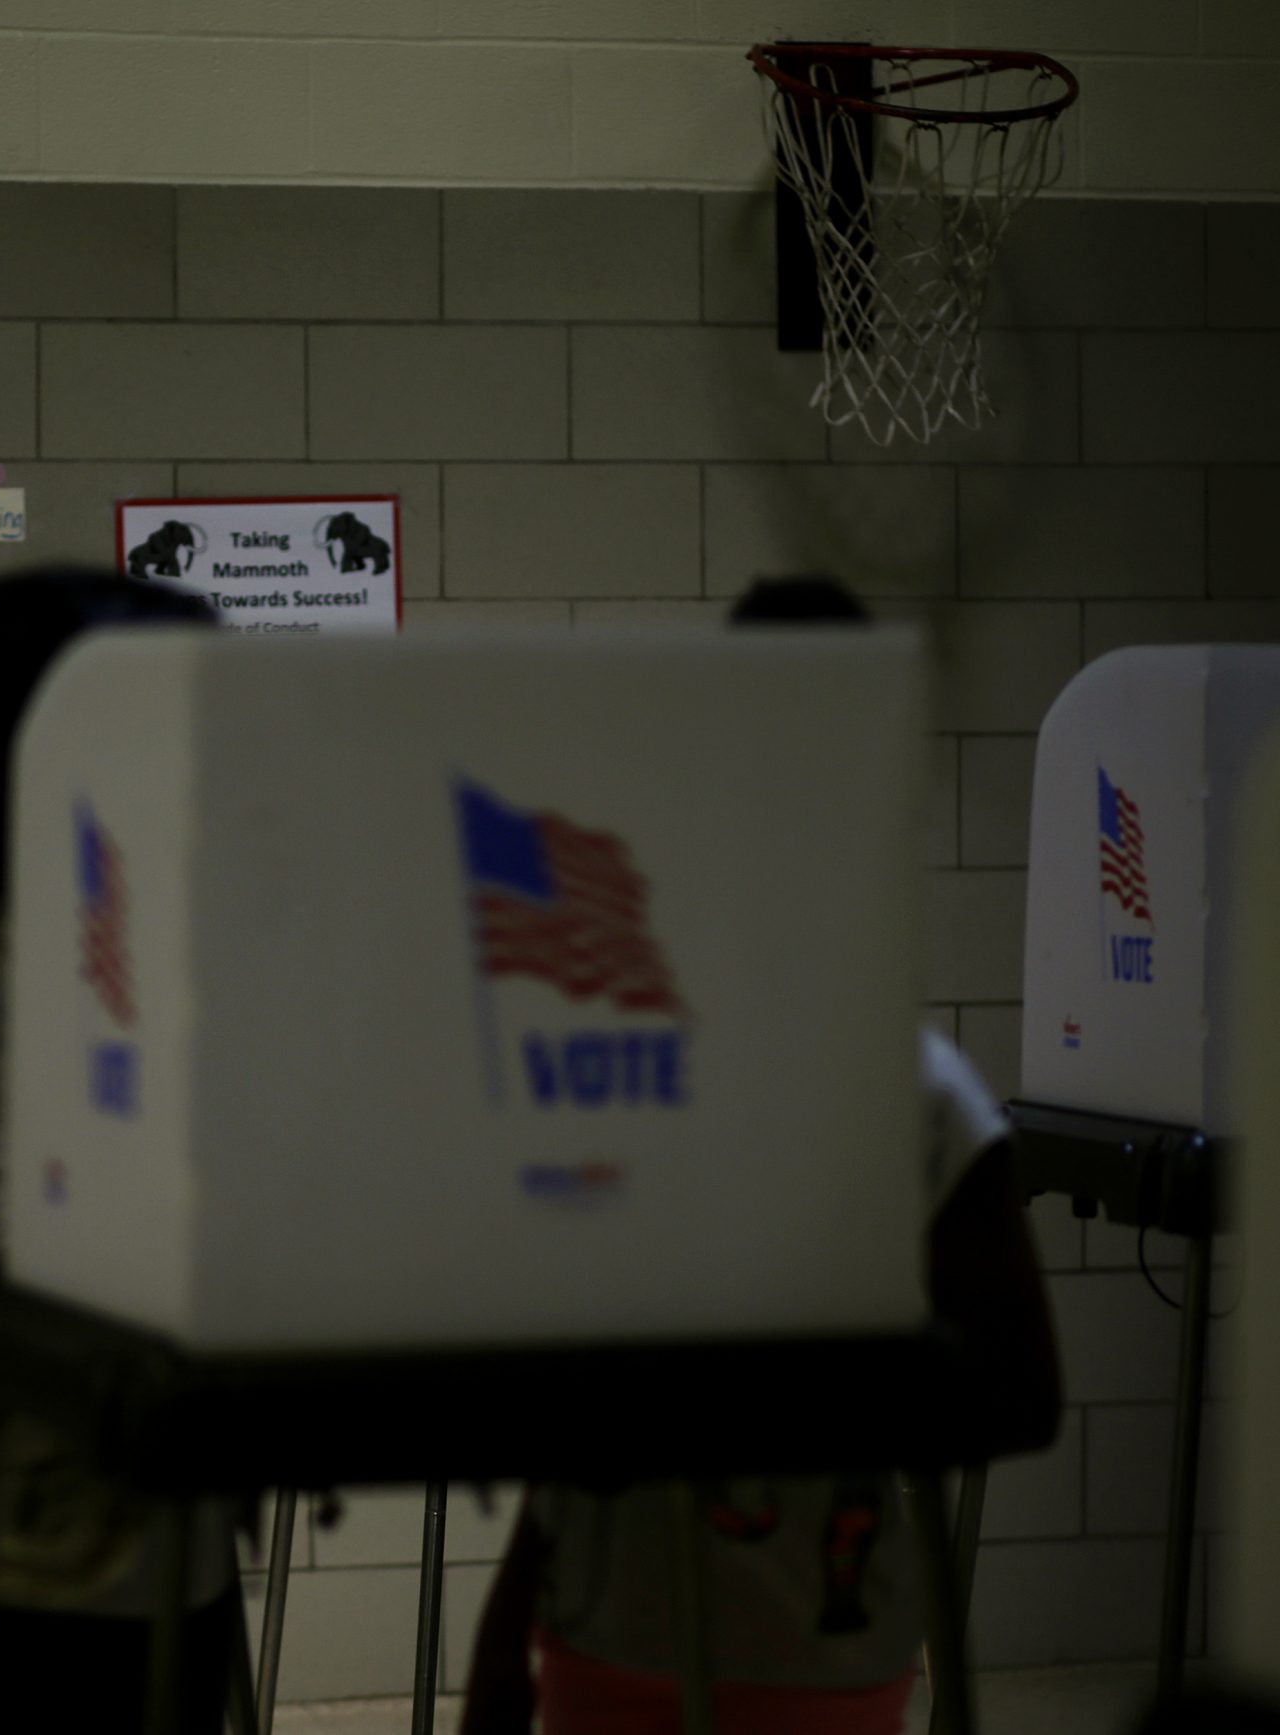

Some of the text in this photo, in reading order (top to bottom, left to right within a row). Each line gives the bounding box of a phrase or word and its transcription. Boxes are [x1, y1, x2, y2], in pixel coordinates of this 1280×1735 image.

[230, 531, 290, 551] Taking
[212, 562, 309, 579] Mammoth
[210, 590, 288, 608] Towards
[293, 588, 369, 607] Success!
[1110, 934, 1153, 983] VOTE
[523, 1028, 690, 1108] VOTE
